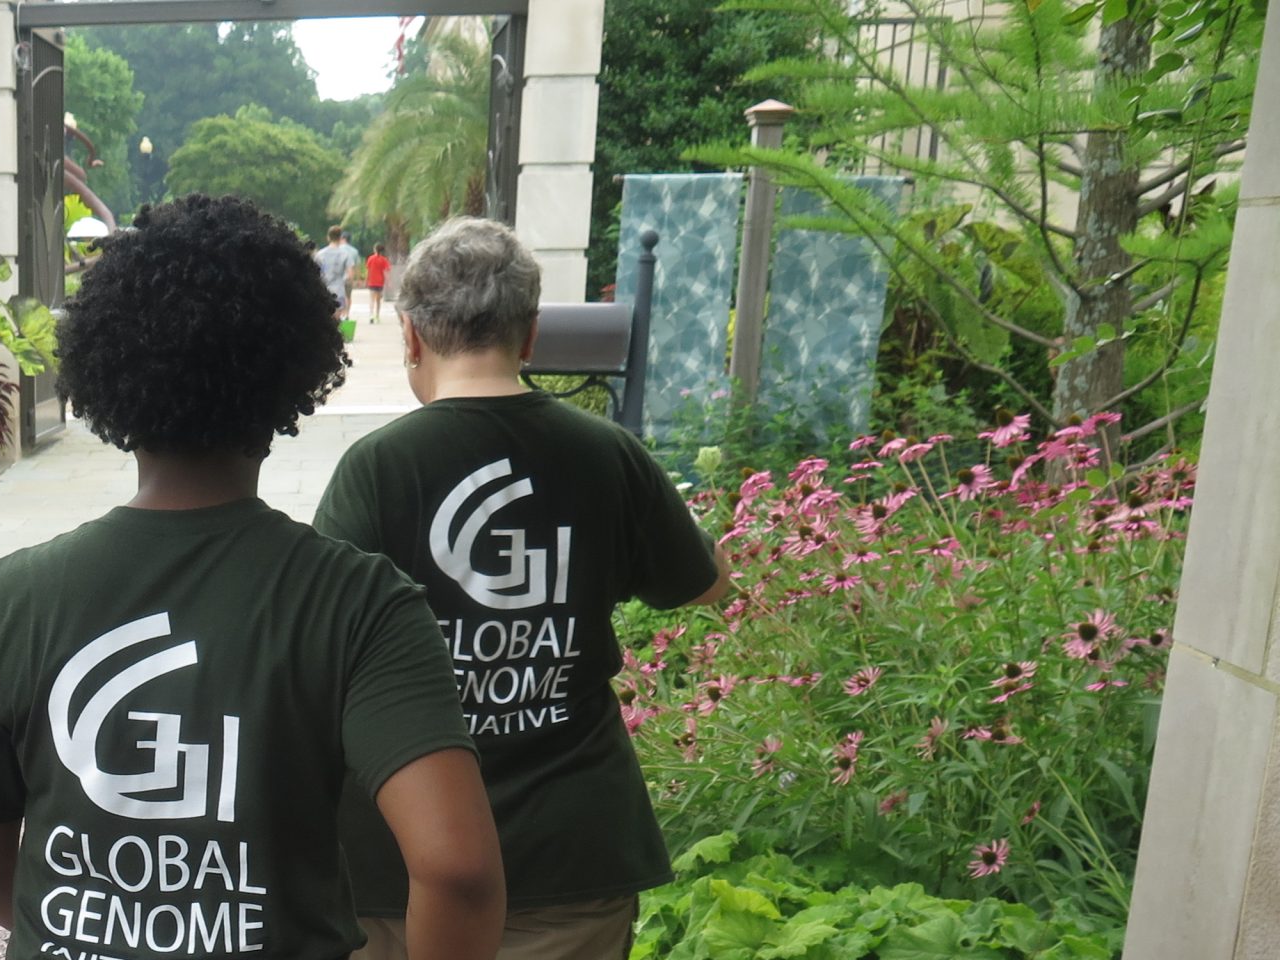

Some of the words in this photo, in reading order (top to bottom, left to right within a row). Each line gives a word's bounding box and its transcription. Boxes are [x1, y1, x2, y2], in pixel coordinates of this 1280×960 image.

[453, 664, 574, 704] NOME
[44, 825, 267, 895] GLOBAL
[40, 885, 265, 955] GENOME
